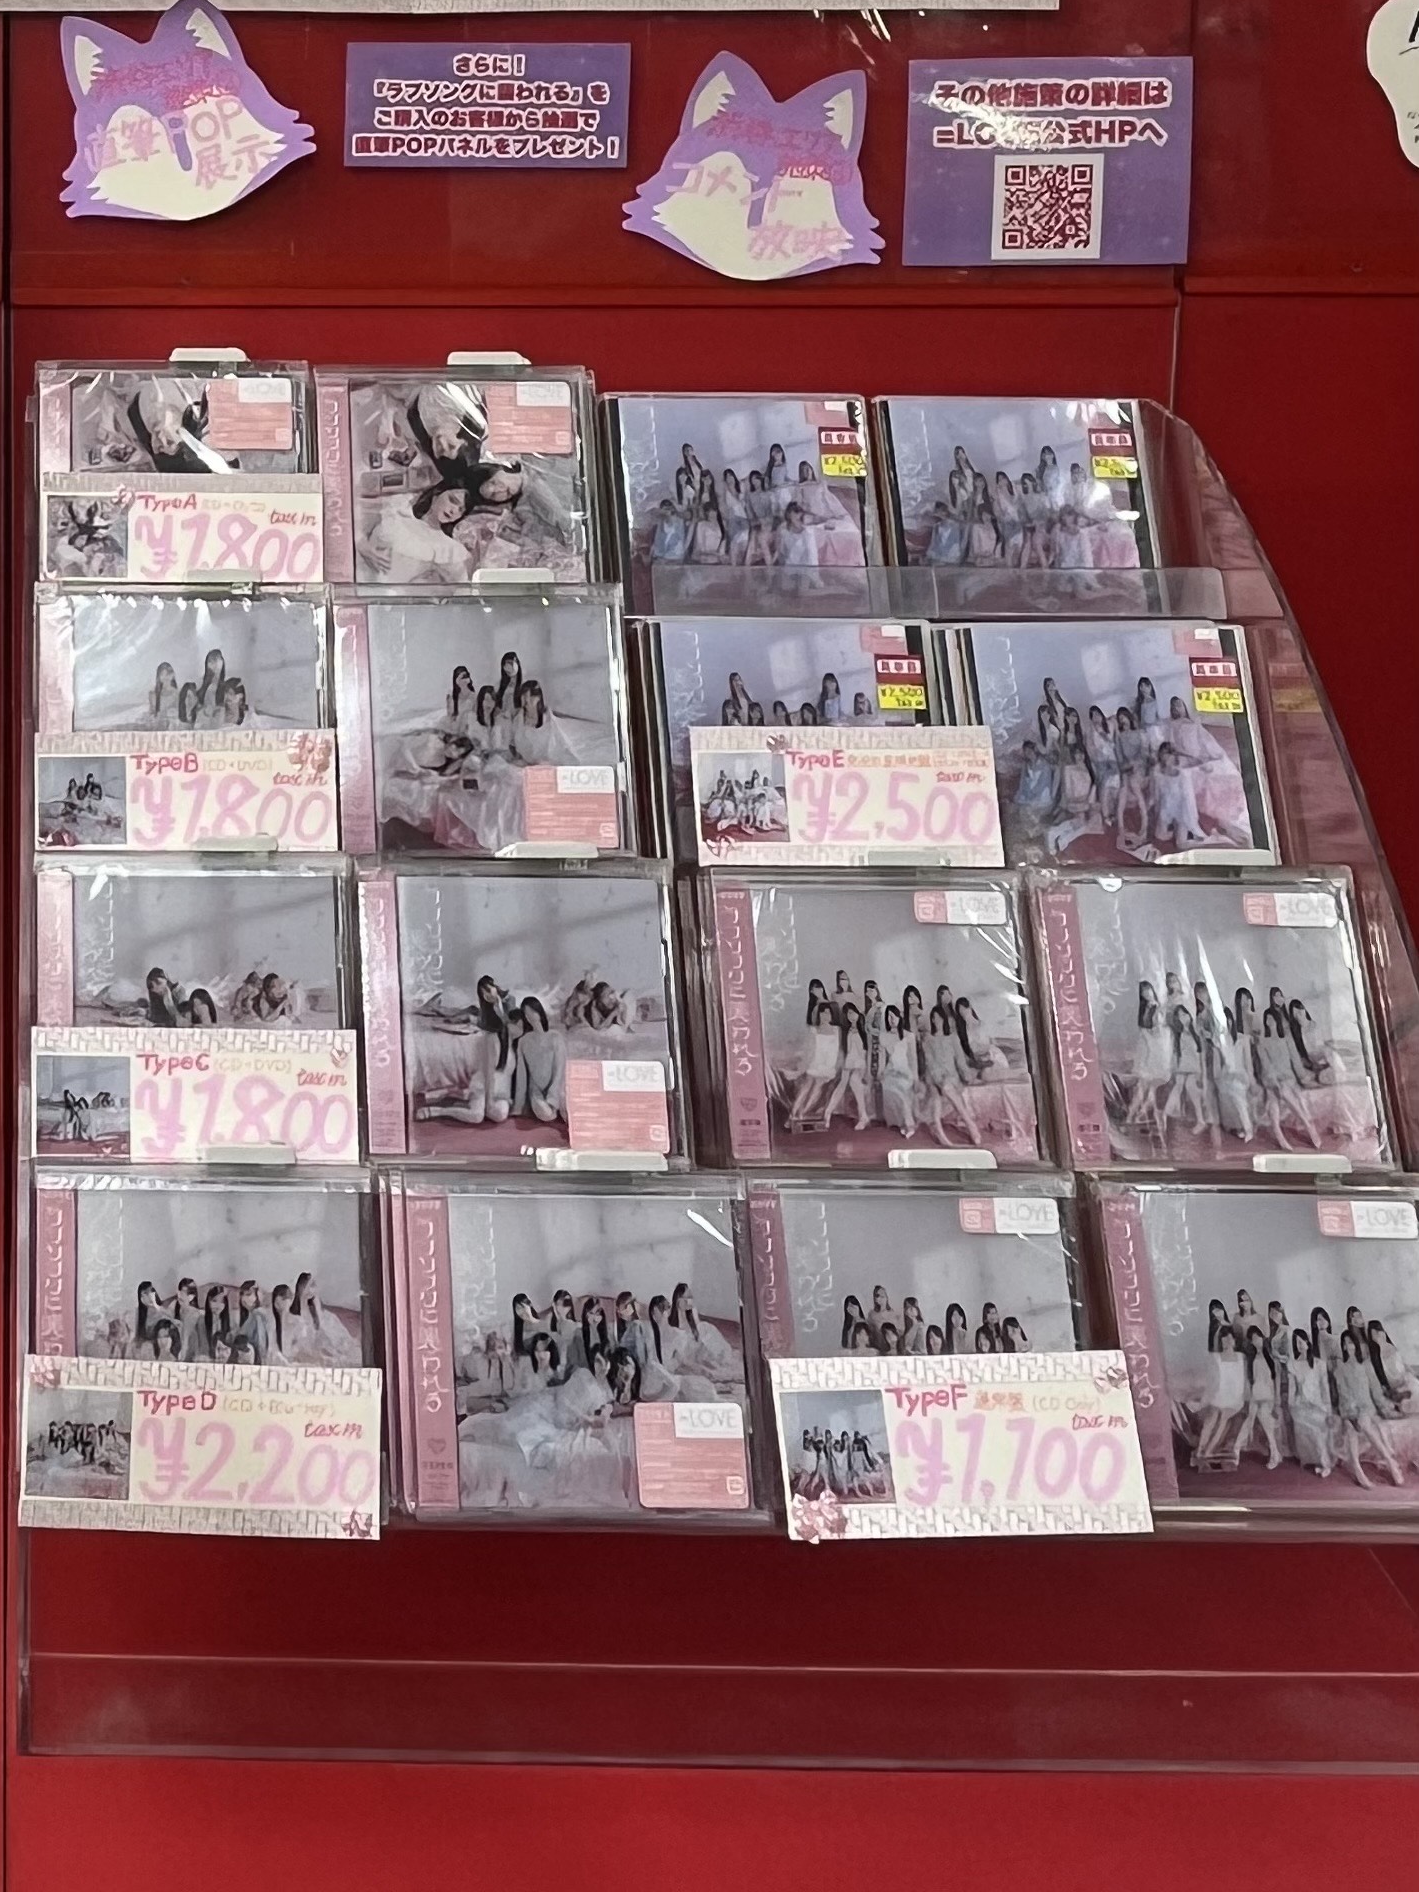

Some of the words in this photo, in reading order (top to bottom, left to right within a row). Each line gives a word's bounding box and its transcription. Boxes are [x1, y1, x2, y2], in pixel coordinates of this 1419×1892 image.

[374, 107, 600, 131] ご入のおからで
[353, 134, 620, 159] POPパネルをプレゼント!
[792, 770, 995, 844] ¥2,500
[137, 1416, 377, 1507] ¥2,200
